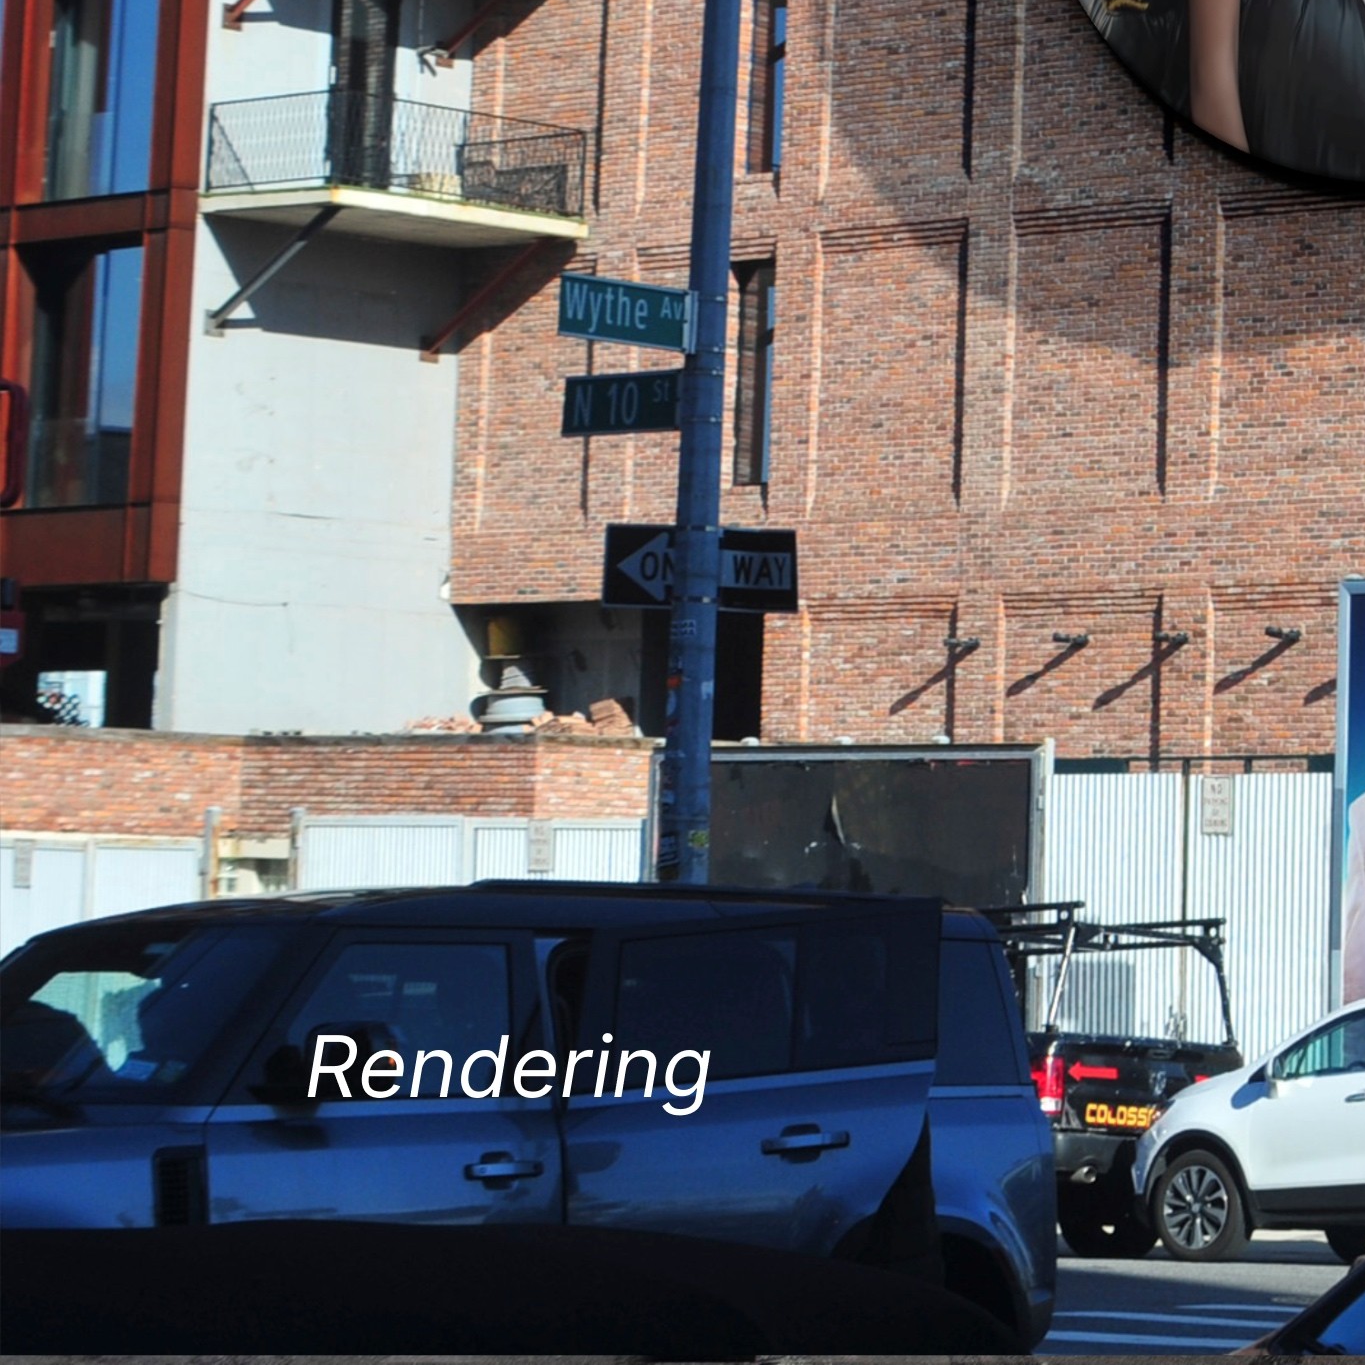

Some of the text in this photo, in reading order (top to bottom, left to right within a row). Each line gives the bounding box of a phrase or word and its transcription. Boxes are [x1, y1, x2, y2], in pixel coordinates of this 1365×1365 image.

[564, 281, 648, 333] Wythe
[573, 379, 669, 427] N 10 St
[640, 551, 788, 586] ON WAY
